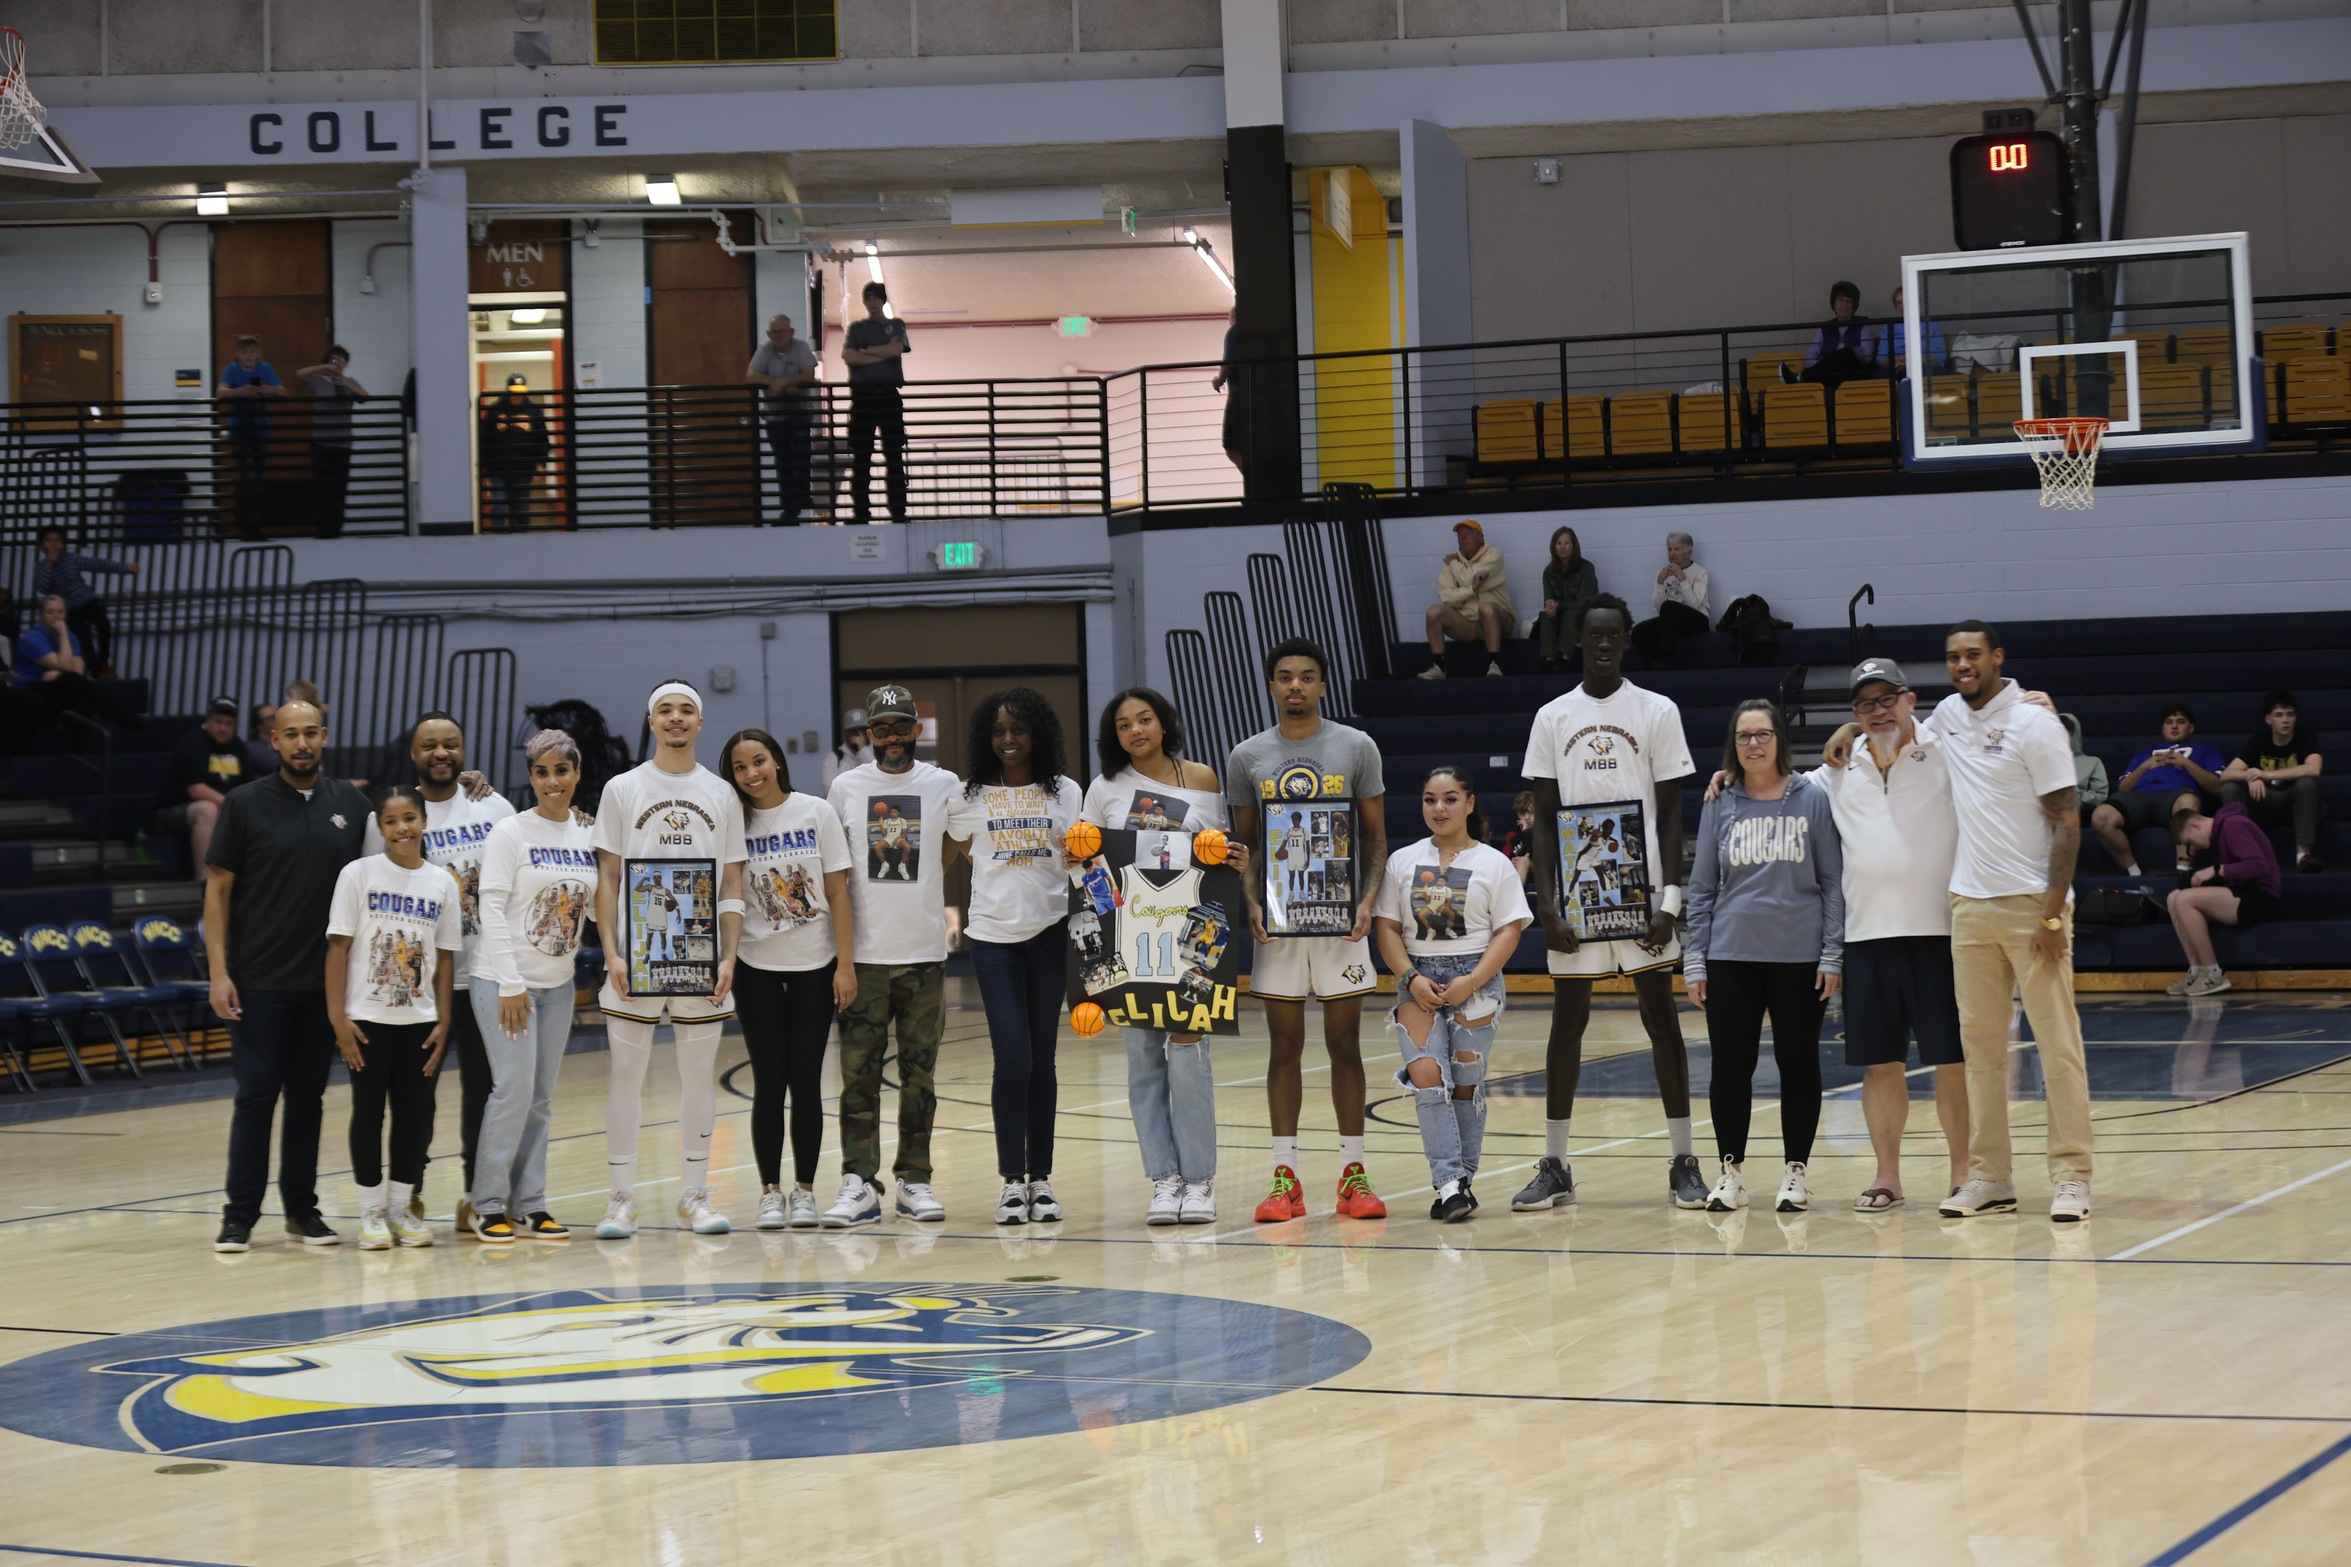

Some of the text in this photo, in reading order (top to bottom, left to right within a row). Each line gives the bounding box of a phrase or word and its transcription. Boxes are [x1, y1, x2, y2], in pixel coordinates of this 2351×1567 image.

[250, 104, 627, 154] COLLEGE
[486, 243, 543, 263] MEN
[1063, 317, 1087, 335] EXIT
[944, 543, 975, 566] EXIT
[882, 691, 897, 706] NY
[1564, 725, 1639, 757] WESTERN NEBRASKA
[1272, 757, 1325, 777] WESTERN NEBRASKA
[1584, 758, 1617, 770] MBB
[1323, 775, 1345, 795] 26
[982, 788, 1052, 804] SOME PEOPLE
[992, 801, 1044, 809] HAVE TO WAIT
[635, 799, 716, 832] WESTERN NEBRASKA
[992, 818, 1048, 830] TO MEET THEIR
[422, 822, 493, 852] OUGARS
[659, 833, 693, 845] MBB
[745, 828, 817, 858] OUGARS
[989, 829, 1051, 841] FAVORITE
[996, 840, 1049, 851] ATHLETE
[1729, 816, 1808, 866] COUGARS
[1129, 893, 1188, 928] Cougars
[30, 928, 70, 952] WNCC
[74, 925, 113, 948] WNCC
[142, 920, 183, 943] WNCC
[1135, 931, 1175, 977] 11
